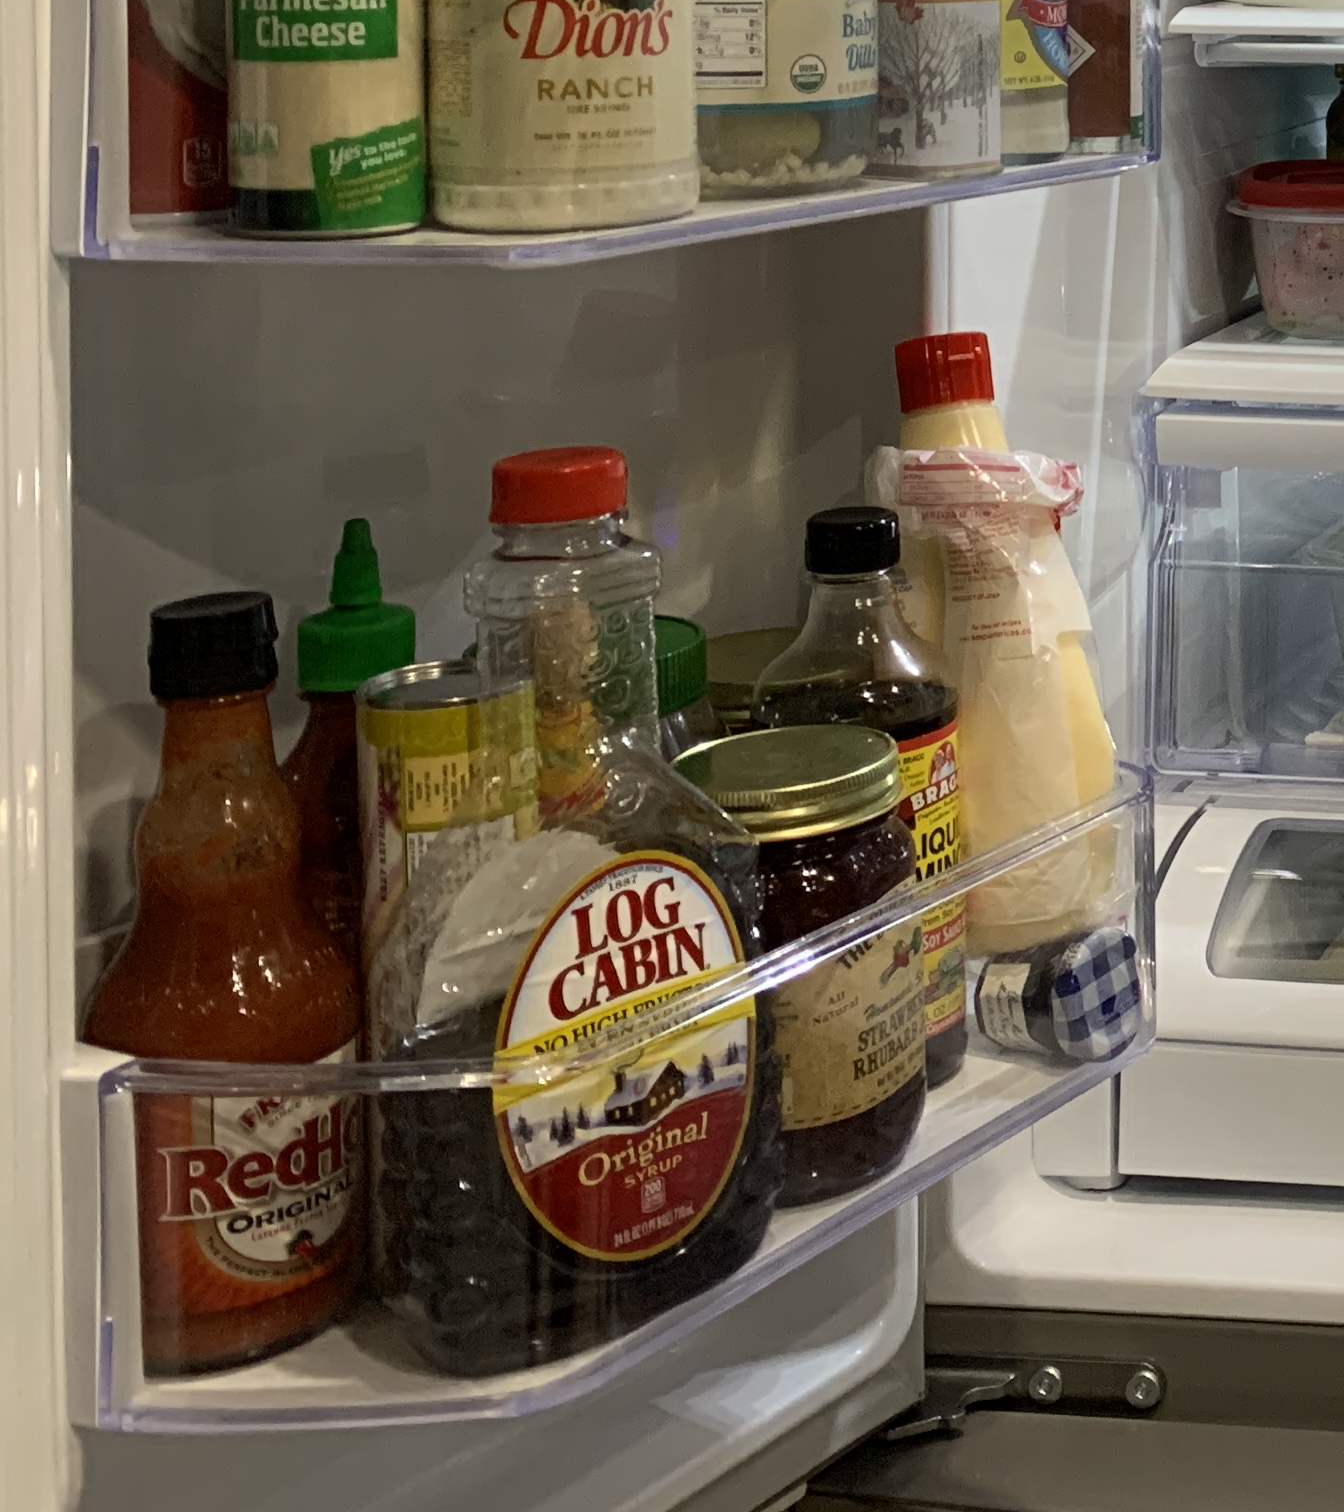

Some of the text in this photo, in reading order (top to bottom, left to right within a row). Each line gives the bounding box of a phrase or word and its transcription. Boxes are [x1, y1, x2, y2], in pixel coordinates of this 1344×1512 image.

[255, 15, 367, 48] Cheese
[841, 10, 877, 39] Baby
[537, 74, 654, 102] RANCH
[328, 144, 362, 177] Yes
[607, 875, 639, 893] 1887
[571, 876, 681, 960] LOG
[549, 923, 708, 1022] CABIN
[811, 995, 859, 1028] Natural
[826, 992, 847, 1007] All
[532, 1012, 627, 1059] NO HIGH
[577, 1113, 709, 1187] Original
[623, 1154, 684, 1189] SYRUP
[643, 1180, 662, 1196] 200
[226, 1176, 354, 1235] ORIGINAL
